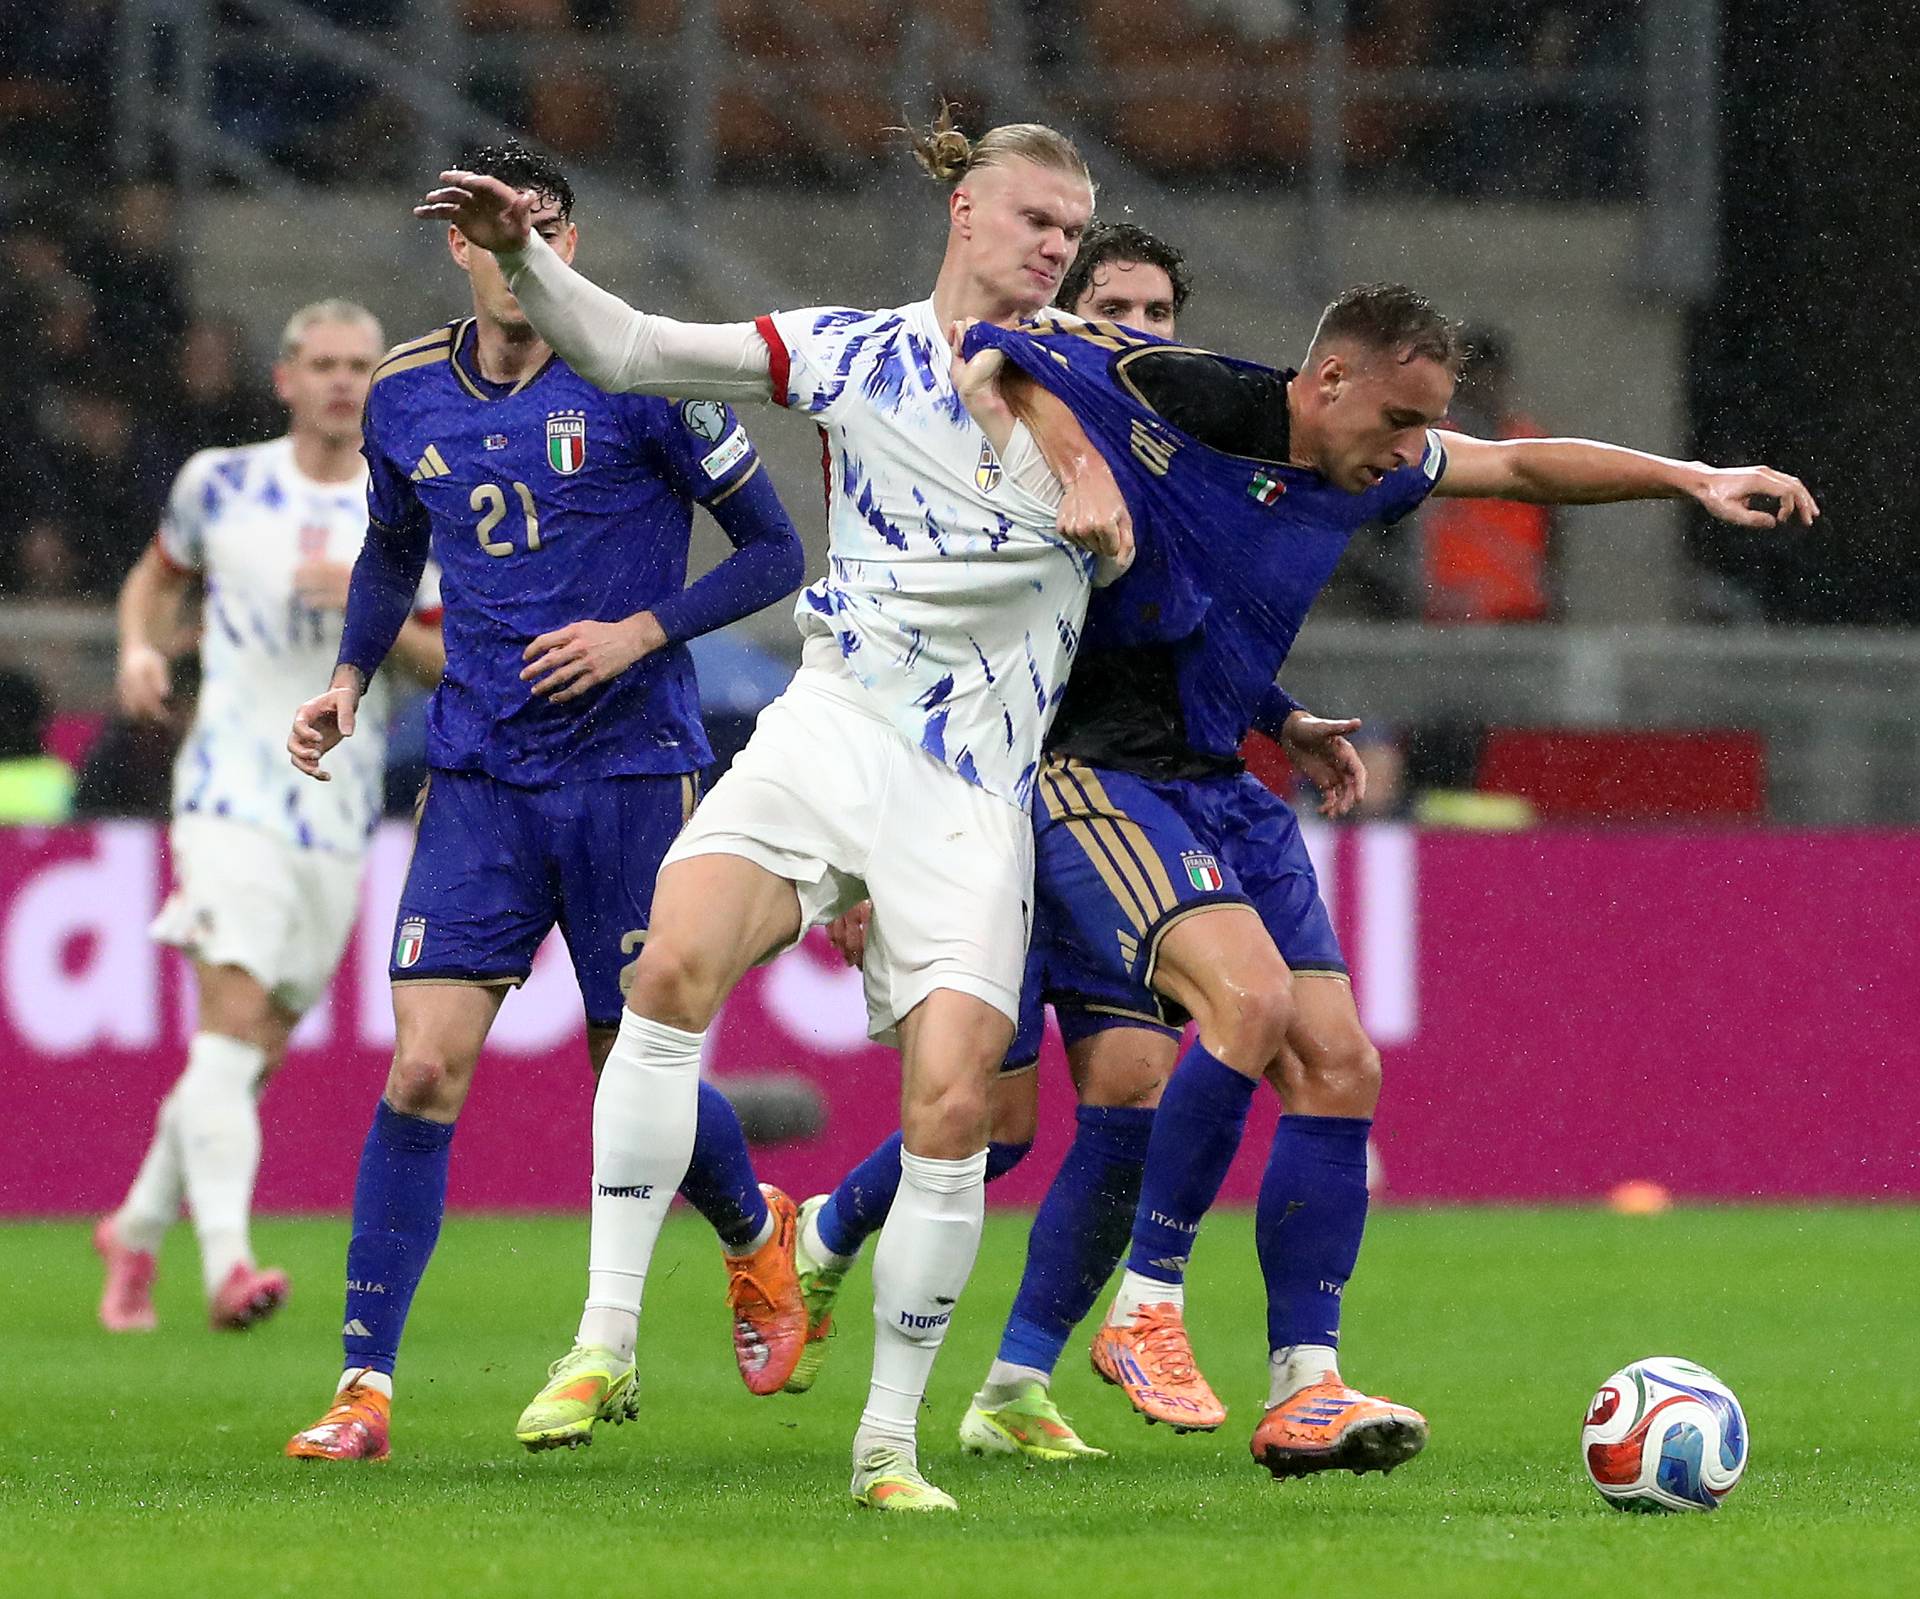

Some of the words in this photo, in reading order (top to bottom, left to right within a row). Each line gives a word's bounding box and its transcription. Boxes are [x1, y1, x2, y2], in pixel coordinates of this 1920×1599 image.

[550, 422, 582, 434] ITALIA
[470, 482, 541, 557] 21
[598, 1184, 654, 1199] NORGE
[1320, 1280, 1342, 1298] ITA
[900, 1311, 951, 1329] NORG
